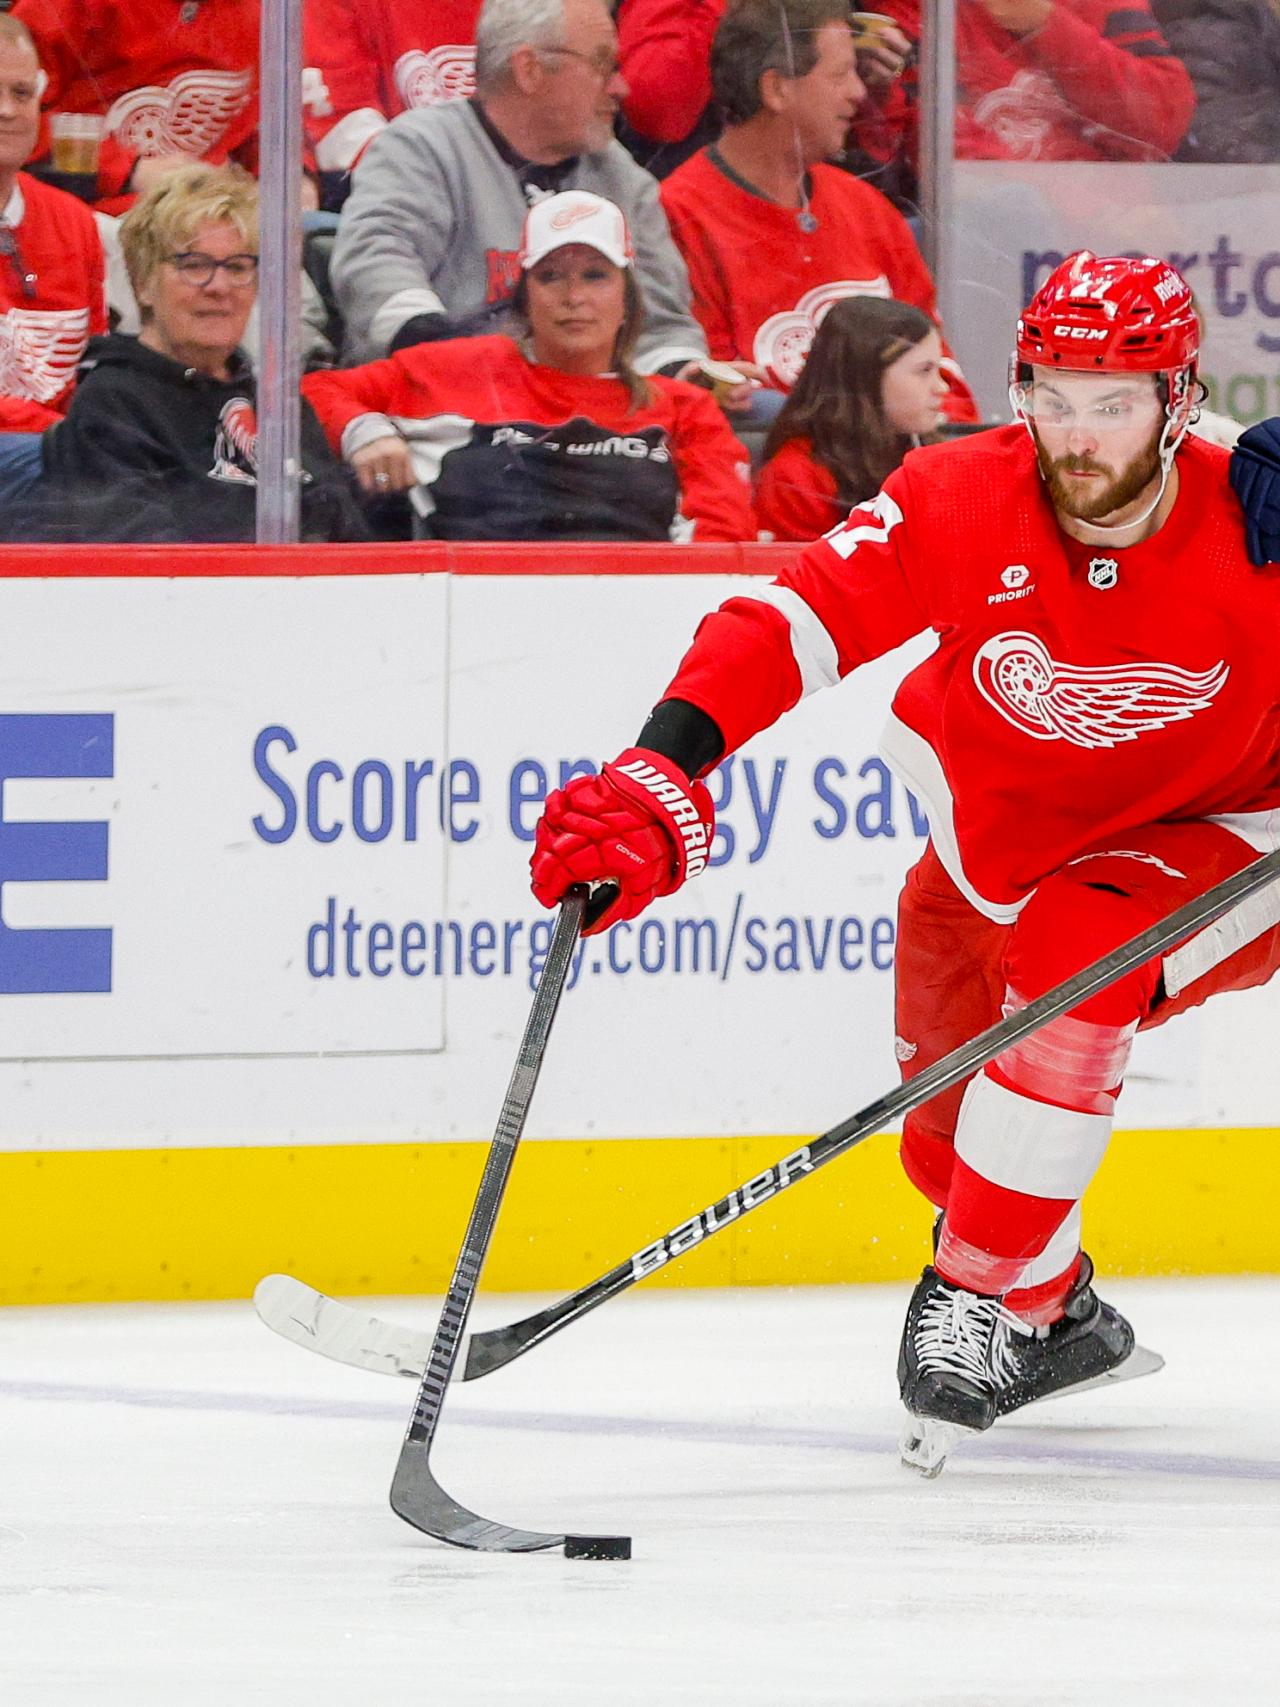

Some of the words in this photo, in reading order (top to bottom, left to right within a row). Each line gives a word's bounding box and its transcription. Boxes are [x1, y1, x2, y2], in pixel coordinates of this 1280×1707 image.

[1053, 325, 1109, 341] CCM
[987, 584, 1036, 606] PRIORITY
[252, 726, 480, 844] Score
[632, 1146, 815, 1281] BAUER
